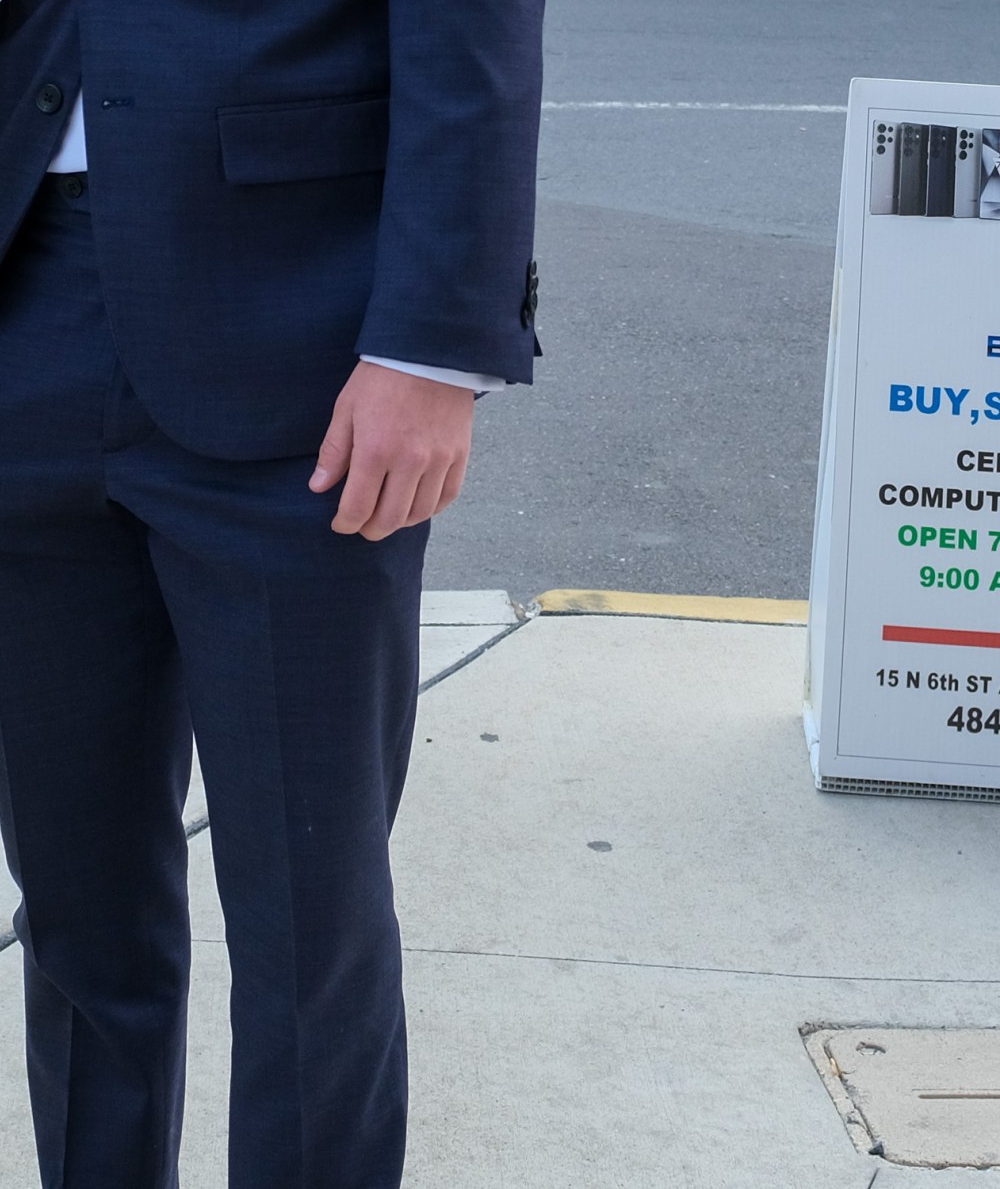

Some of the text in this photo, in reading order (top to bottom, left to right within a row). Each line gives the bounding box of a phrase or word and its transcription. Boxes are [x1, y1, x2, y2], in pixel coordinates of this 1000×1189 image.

[957, 450, 1000, 473] CE
[879, 484, 1000, 512] COMPUT
[898, 525, 977, 550] OPEN
[920, 566, 980, 590] 9:00
[876, 669, 992, 694] 15 N 6th ST
[947, 706, 1000, 734] 484
